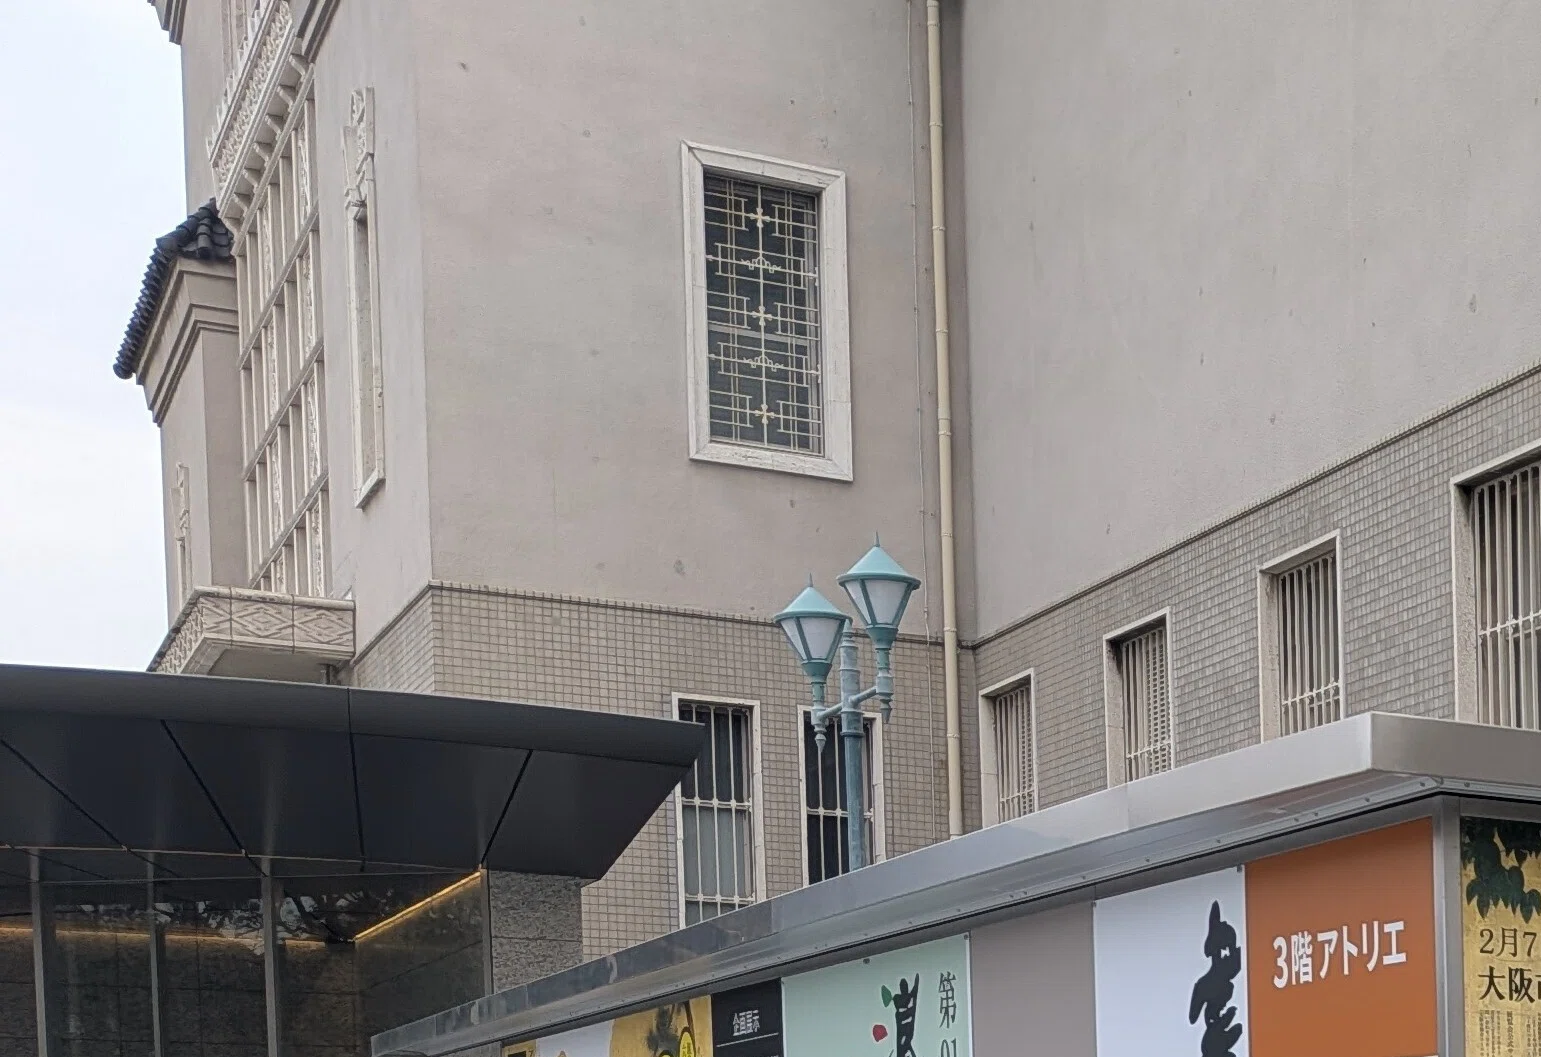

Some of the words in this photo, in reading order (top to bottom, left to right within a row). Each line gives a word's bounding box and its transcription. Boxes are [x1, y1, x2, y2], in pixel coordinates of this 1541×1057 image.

[1273, 919, 1407, 990] 3階アトリエ
